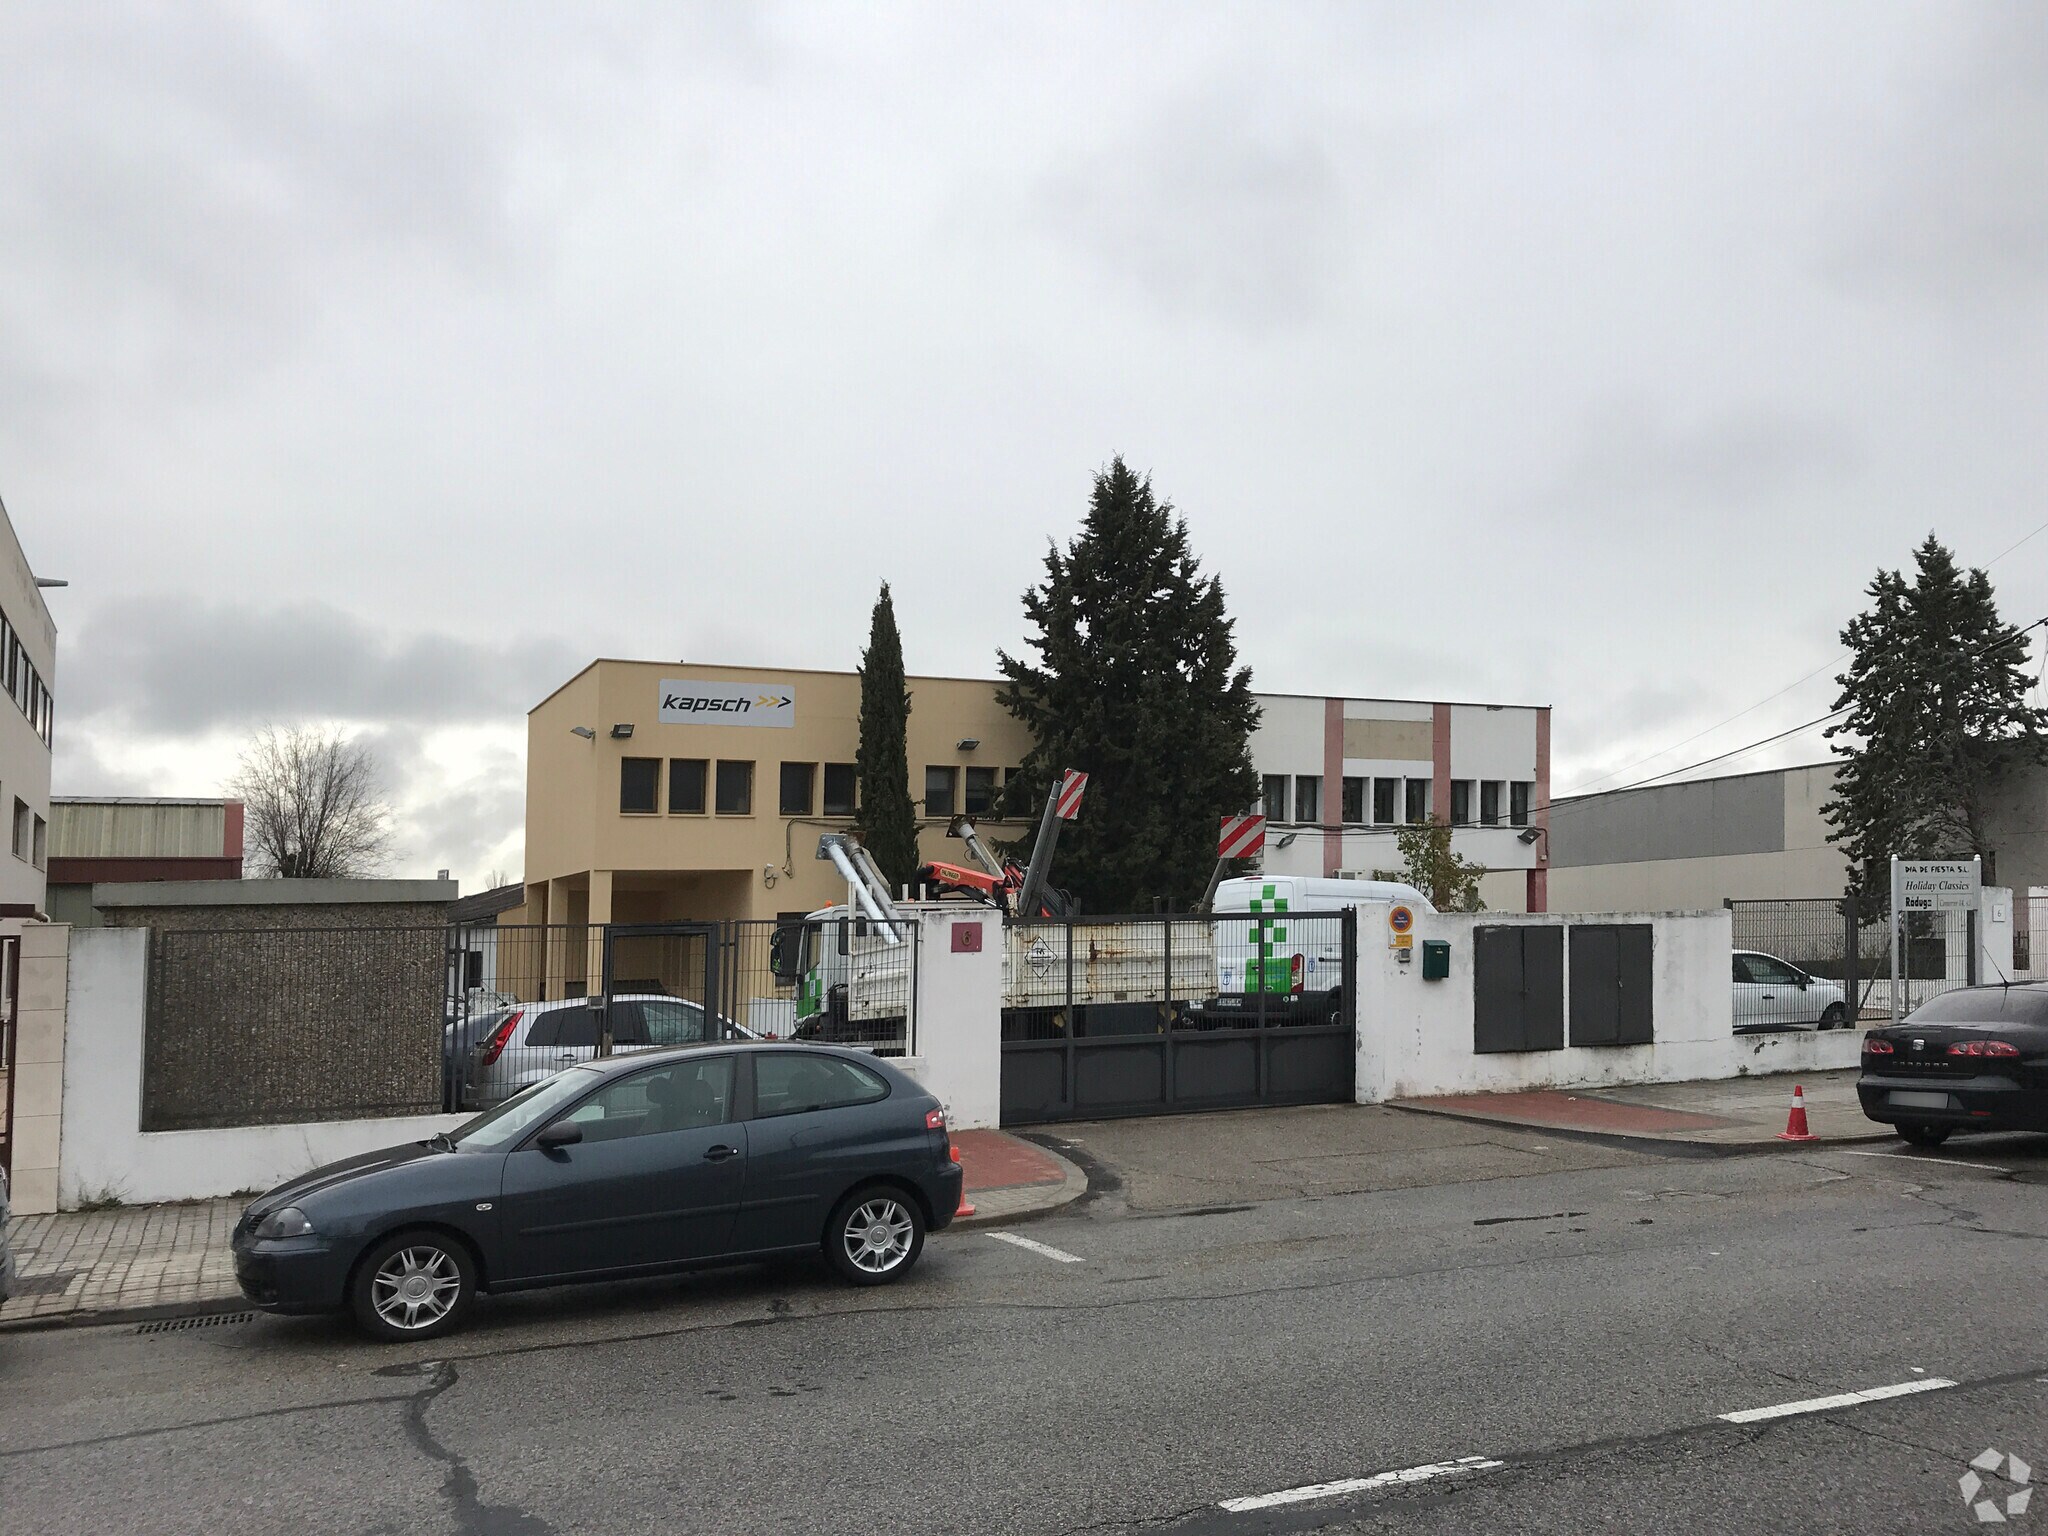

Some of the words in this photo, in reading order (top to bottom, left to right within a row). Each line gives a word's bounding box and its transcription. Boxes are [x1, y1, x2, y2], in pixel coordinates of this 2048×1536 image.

[662, 694, 751, 713] kapsch
[1920, 865, 1928, 873] DE
[1931, 865, 1954, 873] FIESTA
[1905, 881, 1936, 892] Holiday
[1938, 881, 1970, 890] Classics
[962, 929, 972, 946] 6
